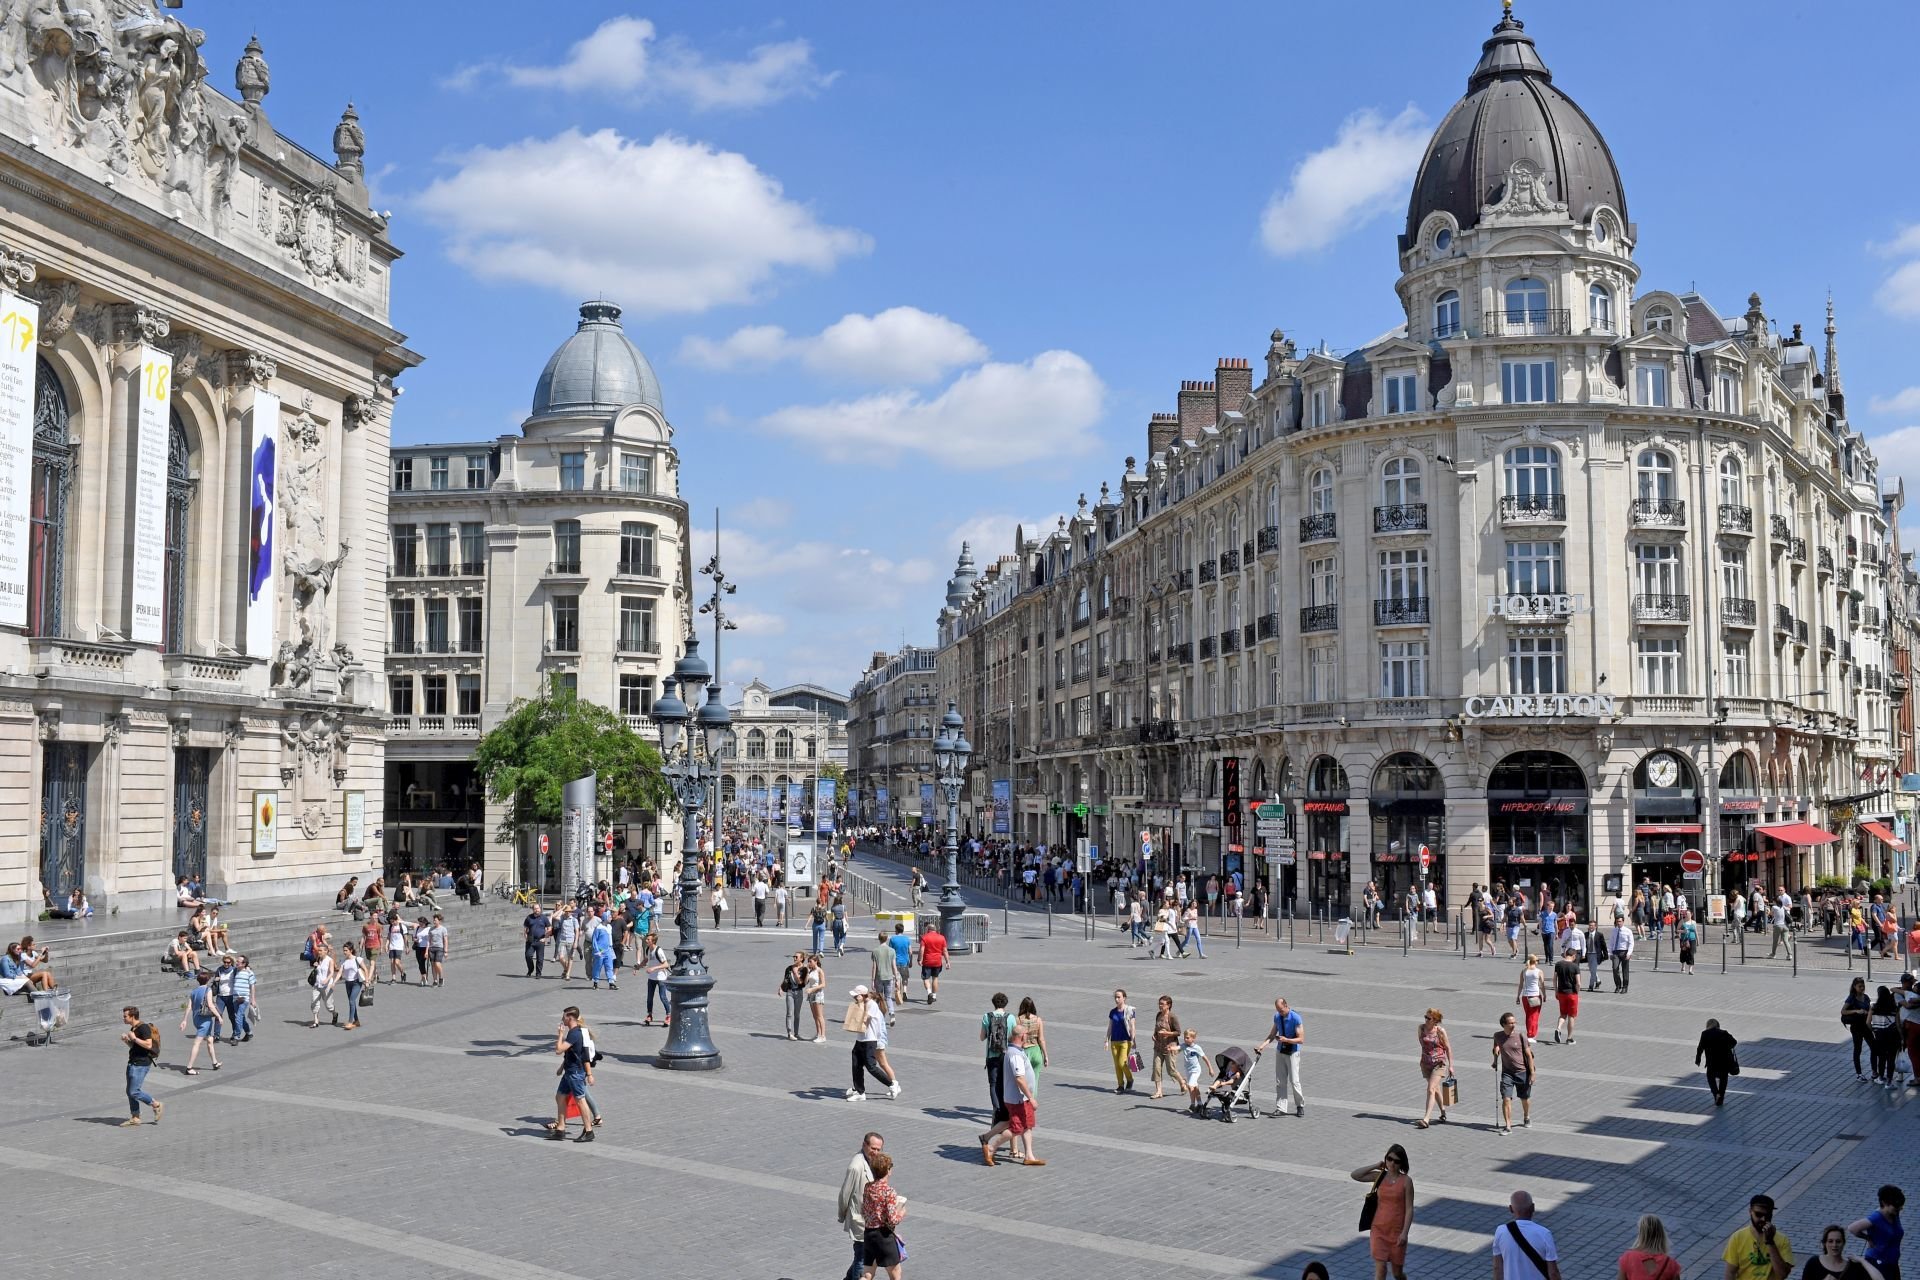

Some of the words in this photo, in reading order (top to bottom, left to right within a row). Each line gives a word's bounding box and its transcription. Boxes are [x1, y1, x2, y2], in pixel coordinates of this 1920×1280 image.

[2, 311, 34, 352] 17
[145, 363, 169, 401] 18
[1485, 594, 1592, 616] HOTEL
[1465, 695, 1615, 718] CARLTON
[1226, 759, 1237, 824] HIPPO
[1501, 803, 1576, 812] HIPPOPOTAMUS
